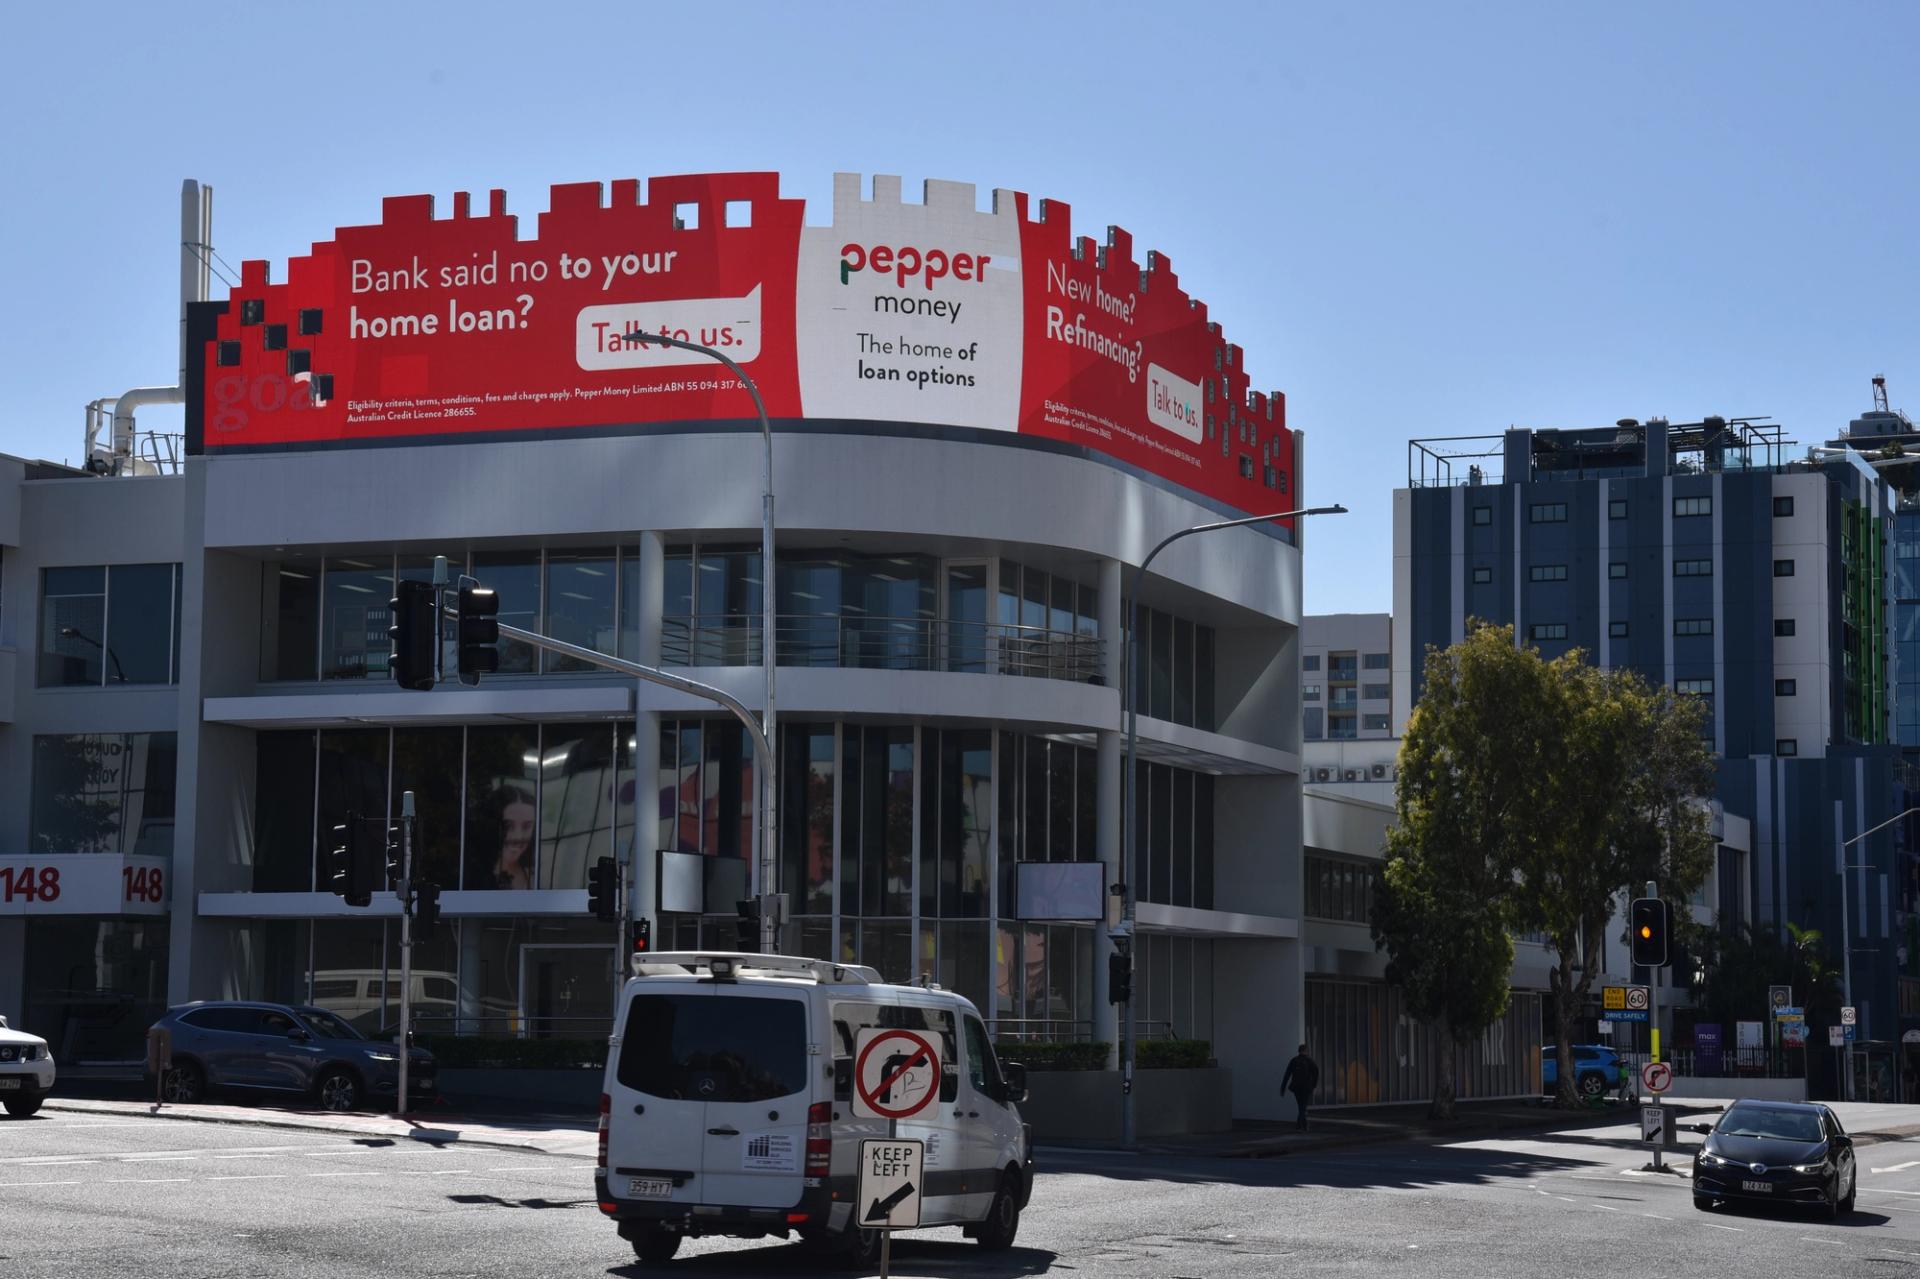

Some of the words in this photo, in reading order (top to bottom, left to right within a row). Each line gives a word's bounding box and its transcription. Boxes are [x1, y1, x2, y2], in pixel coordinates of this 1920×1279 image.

[352, 255, 430, 293] Bank
[440, 250, 497, 287] said
[510, 260, 548, 282] no
[559, 252, 592, 280] to
[601, 250, 678, 291] your
[840, 243, 991, 291] pepper
[1047, 258, 1091, 302] New
[1096, 275, 1136, 325] home?
[350, 305, 439, 339] home
[449, 294, 535, 333] loan?
[874, 295, 962, 324] money
[591, 320, 649, 353] Talk
[700, 326, 743, 347] us.
[856, 332, 893, 354] The
[899, 335, 953, 359] home
[957, 342, 978, 361] of
[1046, 305, 1143, 384] Refinancing?
[858, 359, 900, 381] loan
[906, 365, 976, 390] options
[347, 400, 383, 412] Eligibility
[385, 397, 415, 408] criteria,
[416, 397, 440, 406] terms,
[441, 394, 484, 405] conditions,
[485, 393, 500, 402] fees
[502, 391, 517, 401] and
[518, 391, 547, 403] charges
[549, 388, 573, 401] apply.
[575, 387, 602, 400] Pepper
[603, 385, 631, 397] Money
[632, 383, 663, 394] Limited
[664, 381, 684, 392] ABN
[686, 381, 698, 391] 55
[700, 380, 718, 390] 094
[720, 380, 735, 389] 317
[1152, 379, 1171, 416] Talk
[1173, 396, 1183, 421] to
[1185, 405, 1199, 429] us.
[347, 411, 386, 423] Australian
[387, 410, 412, 421] Credit
[413, 410, 442, 419] Licence
[443, 408, 477, 417] 286655.
[0, 867, 61, 902] 148
[123, 866, 163, 902] 148
[1630, 994, 1644, 1004] 60
[1845, 1026, 1852, 1034] P
[872, 1147, 913, 1161] KEEP
[873, 1163, 910, 1177] LEFT
